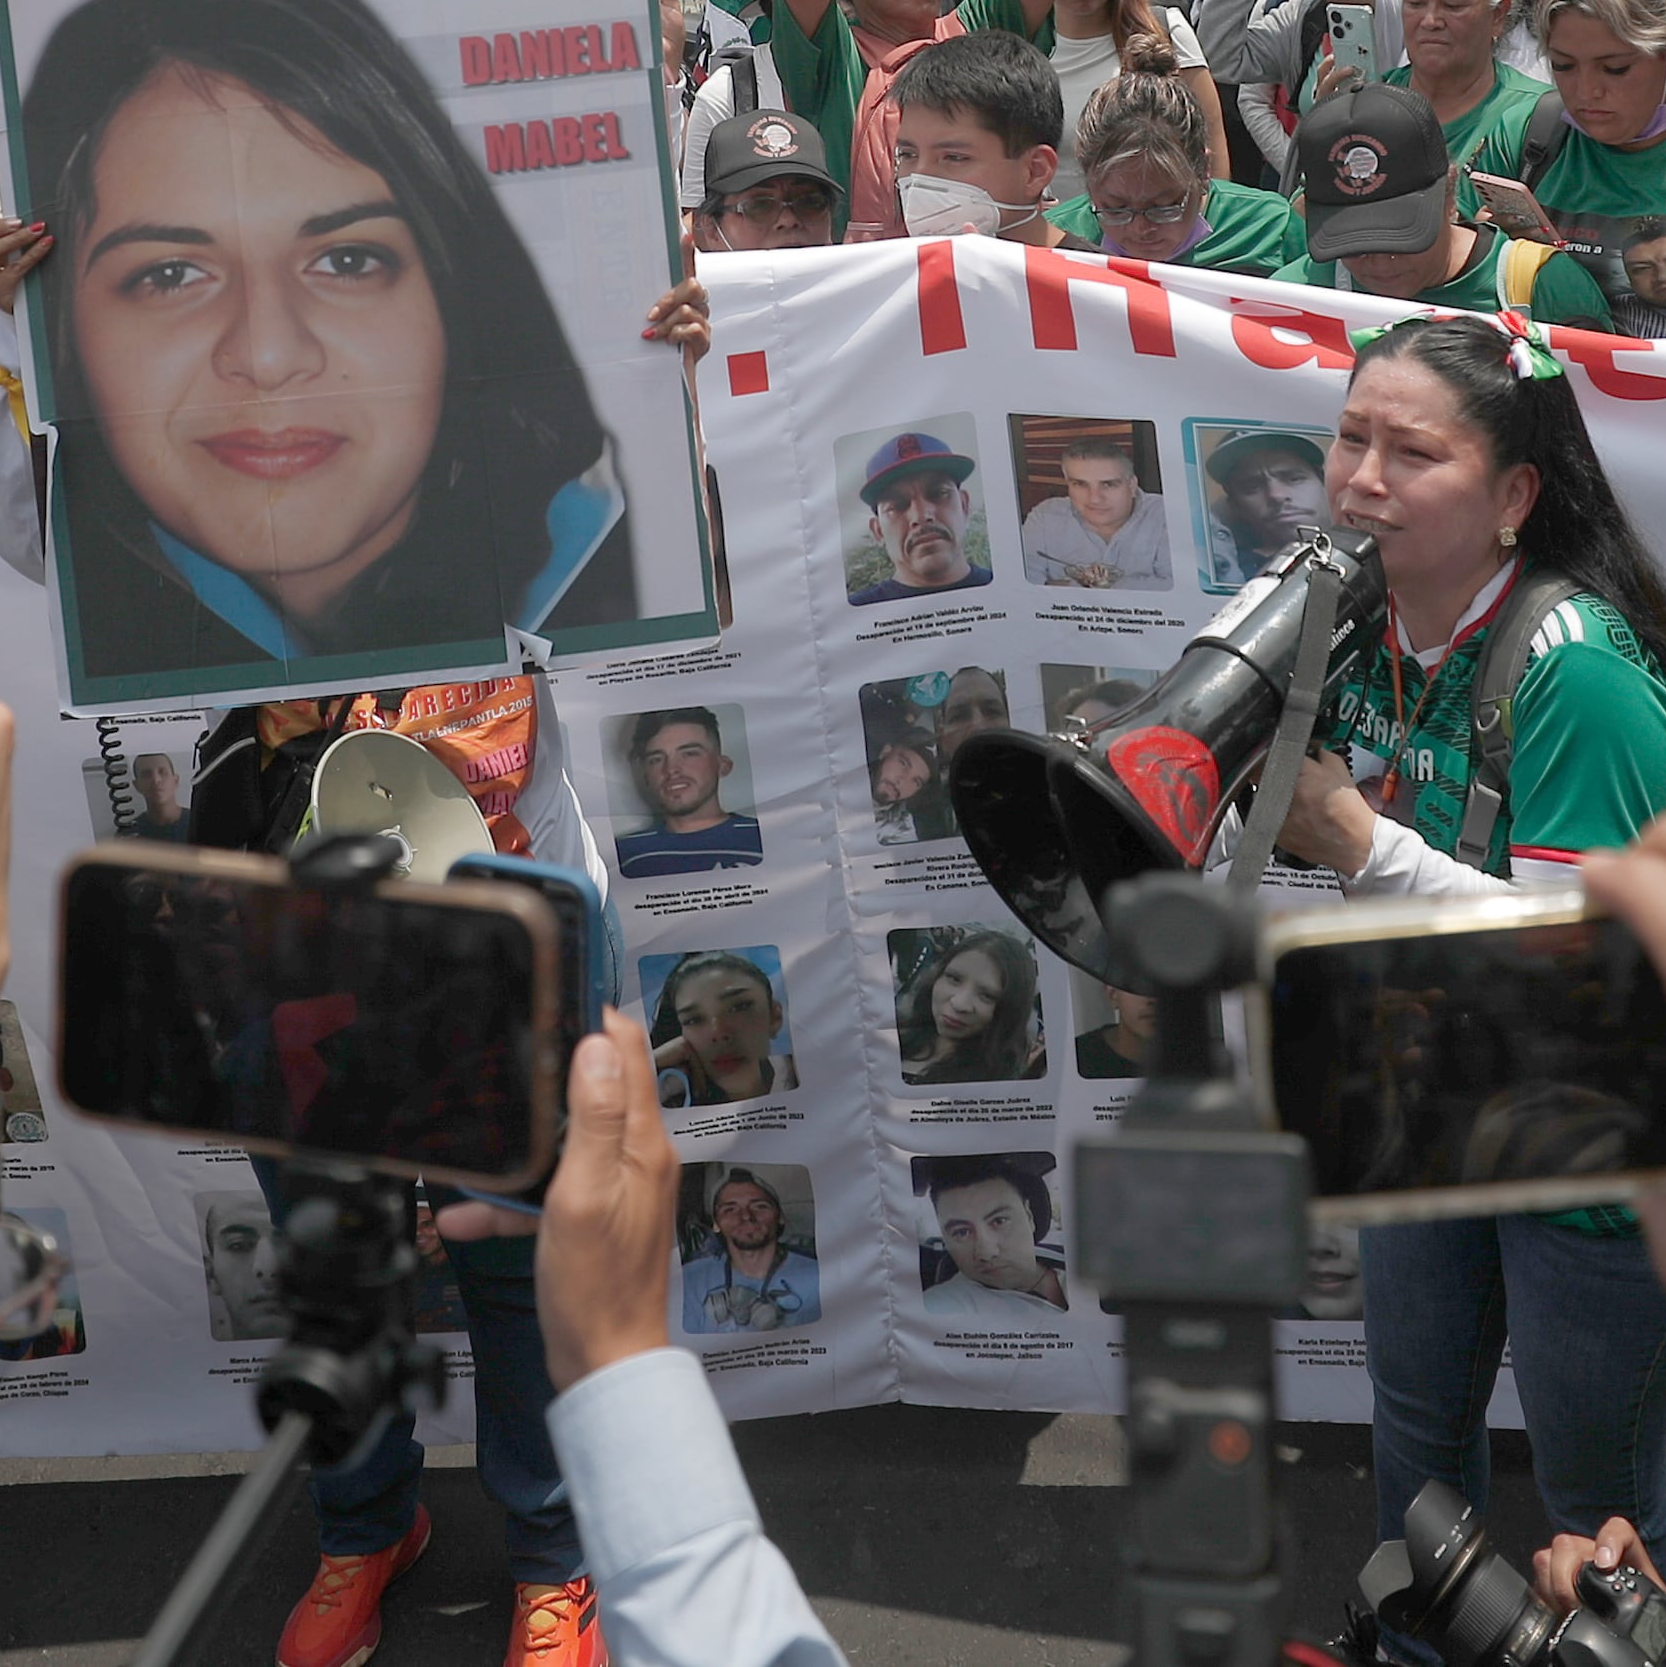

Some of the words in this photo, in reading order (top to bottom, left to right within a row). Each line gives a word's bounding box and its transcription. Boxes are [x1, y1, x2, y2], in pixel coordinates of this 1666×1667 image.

[459, 19, 641, 88] DANIELA
[483, 110, 631, 175] MABEL
[509, 696, 533, 713] 2015
